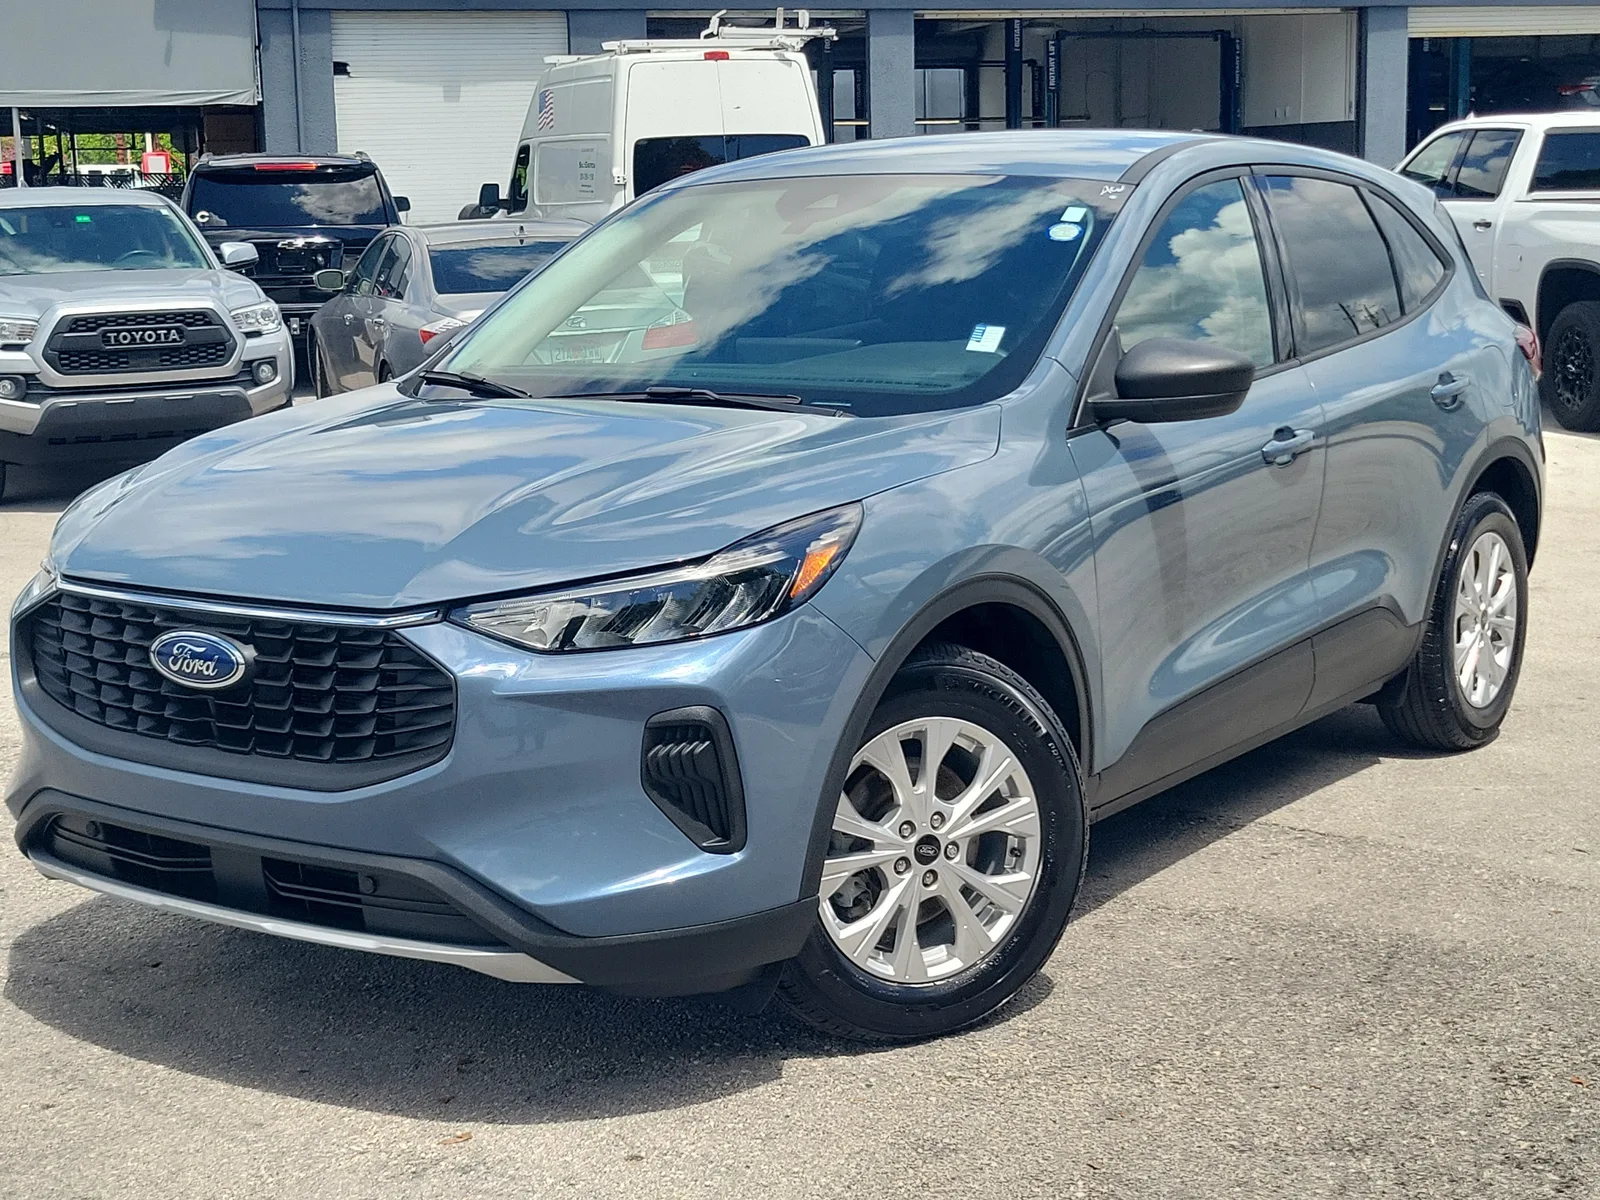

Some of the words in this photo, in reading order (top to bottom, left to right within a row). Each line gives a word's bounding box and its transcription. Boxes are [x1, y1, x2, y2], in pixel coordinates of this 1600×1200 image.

[1048, 40, 1056, 56] LIFT
[1048, 57, 1056, 86] ROTARY
[106, 329, 180, 345] TOYOTA
[168, 642, 219, 676] Ford
